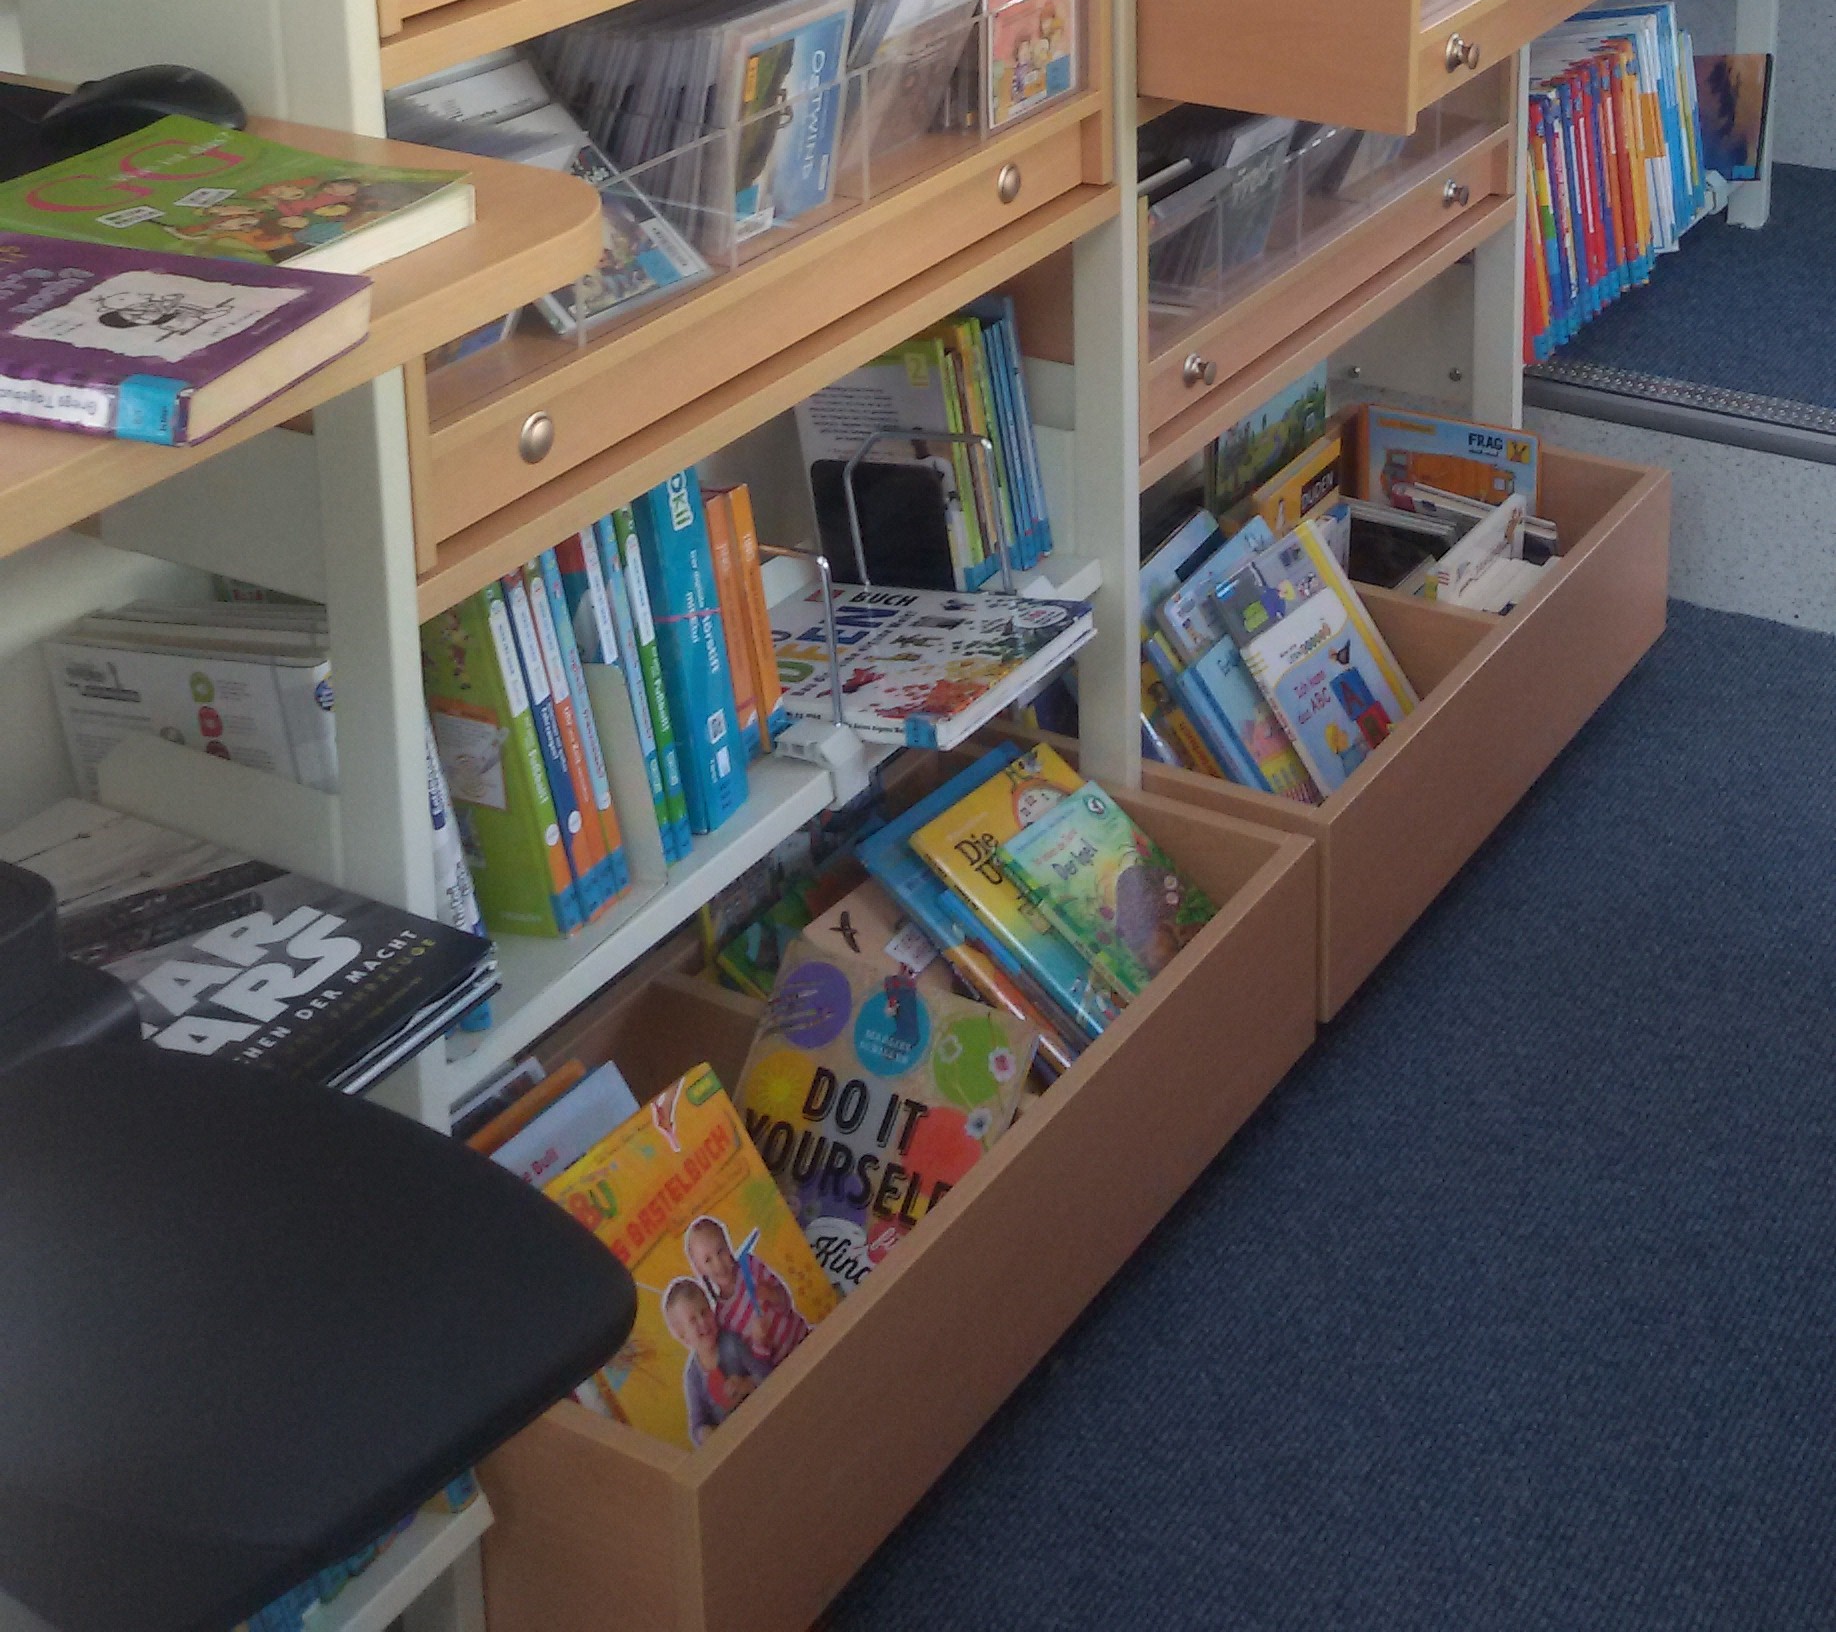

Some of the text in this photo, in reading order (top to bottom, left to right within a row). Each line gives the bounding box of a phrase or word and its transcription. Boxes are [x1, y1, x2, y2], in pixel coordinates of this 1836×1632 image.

[848, 590, 920, 607] BUCH
[954, 832, 999, 866] Die
[296, 986, 346, 1022] DER
[348, 927, 420, 985] MACHT
[801, 1065, 930, 1156] DO IT
[625, 1123, 731, 1249] BASTELBUCH
